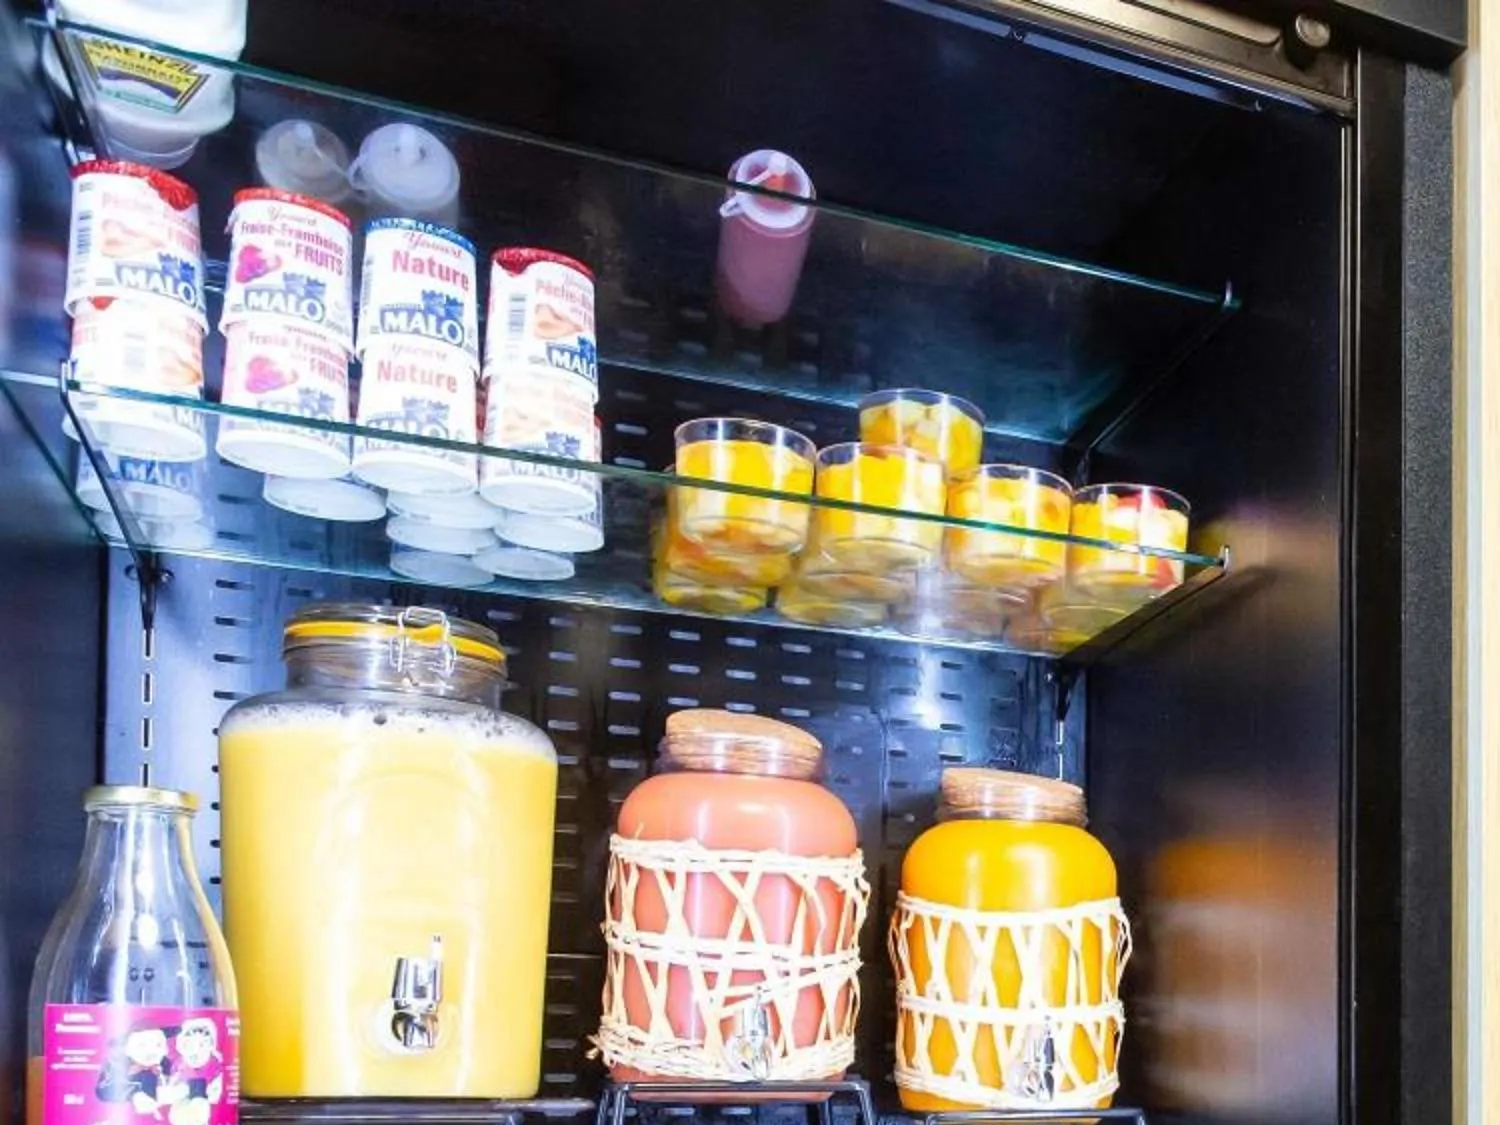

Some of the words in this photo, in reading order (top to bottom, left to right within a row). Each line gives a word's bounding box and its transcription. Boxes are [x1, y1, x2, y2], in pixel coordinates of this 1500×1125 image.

[295, 243, 344, 277] FRUITS
[393, 249, 470, 292] Nature
[120, 266, 195, 306] MALO
[246, 290, 323, 322] MALO
[382, 310, 463, 346] MALO
[377, 359, 458, 394] Nature
[125, 458, 191, 490] MALO
